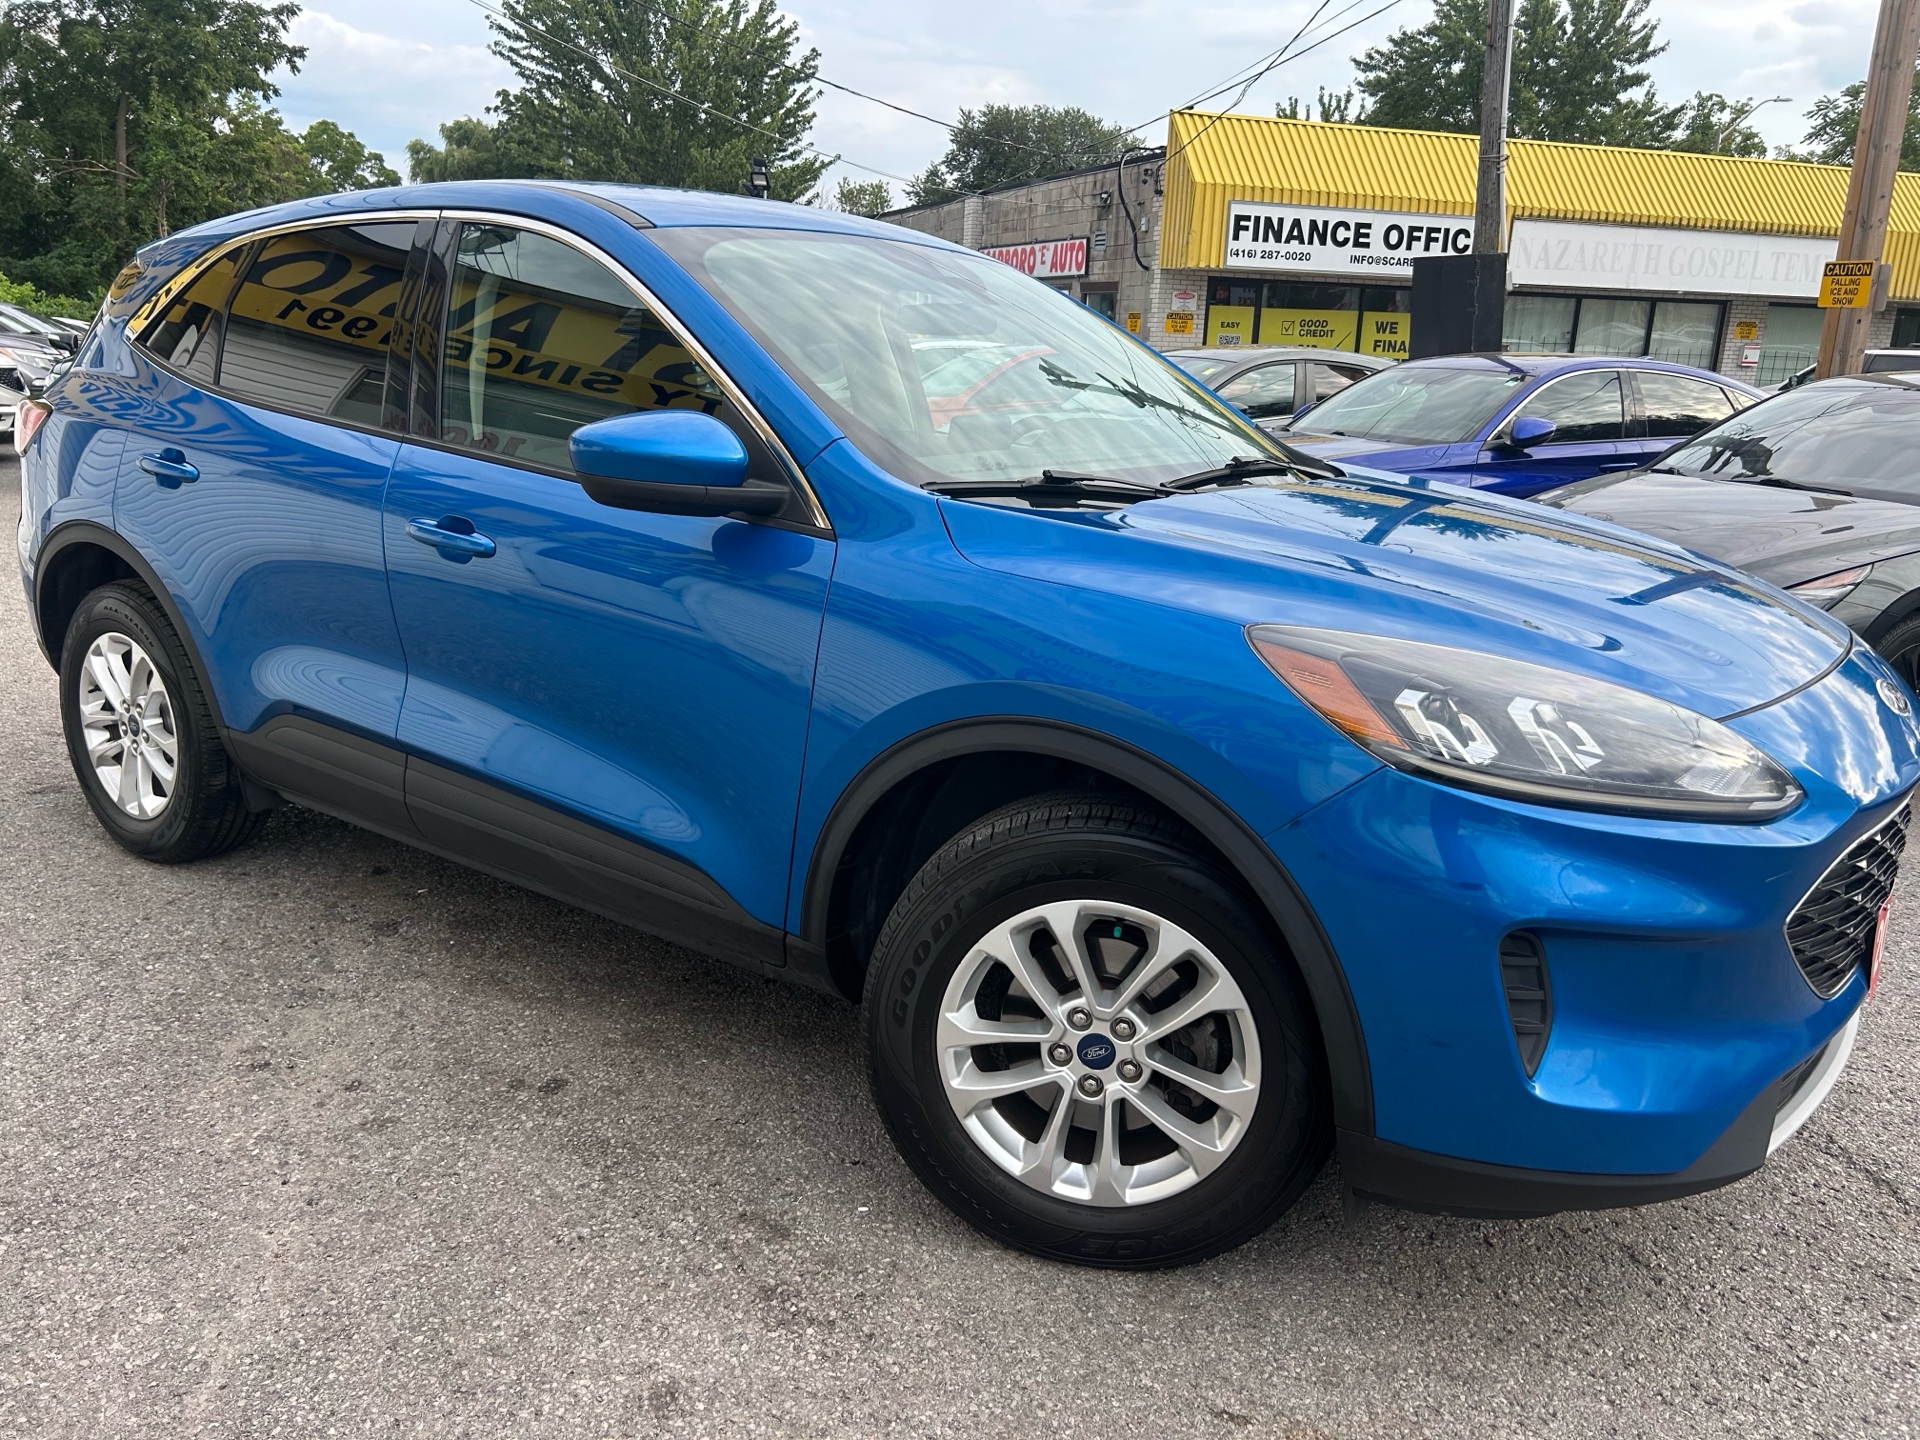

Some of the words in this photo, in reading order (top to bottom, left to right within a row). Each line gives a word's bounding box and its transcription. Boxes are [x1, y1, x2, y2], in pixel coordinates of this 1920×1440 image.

[1232, 213, 1372, 249] FINANCE
[1382, 223, 1472, 255] OFFIC
[1049, 241, 1086, 273] AUTO
[1229, 248, 1257, 259] (416)
[1260, 249, 1311, 262] 287-0020
[1515, 236, 1664, 276] NAZARETH
[1668, 245, 1763, 280] GOSPEL
[1826, 264, 1871, 276] CAUTION
[1831, 278, 1861, 287] FALLING
[1830, 287, 1842, 296] ICE
[1843, 287, 1859, 296] AND
[1831, 296, 1854, 305] SNOW
[1220, 321, 1240, 329] EASY
[1299, 319, 1328, 329] GOOD
[1375, 320, 1399, 335] WE
[1298, 328, 1335, 338] CREDIT
[1372, 339, 1408, 353] FINA
[1086, 1047, 1106, 1059] Ford
